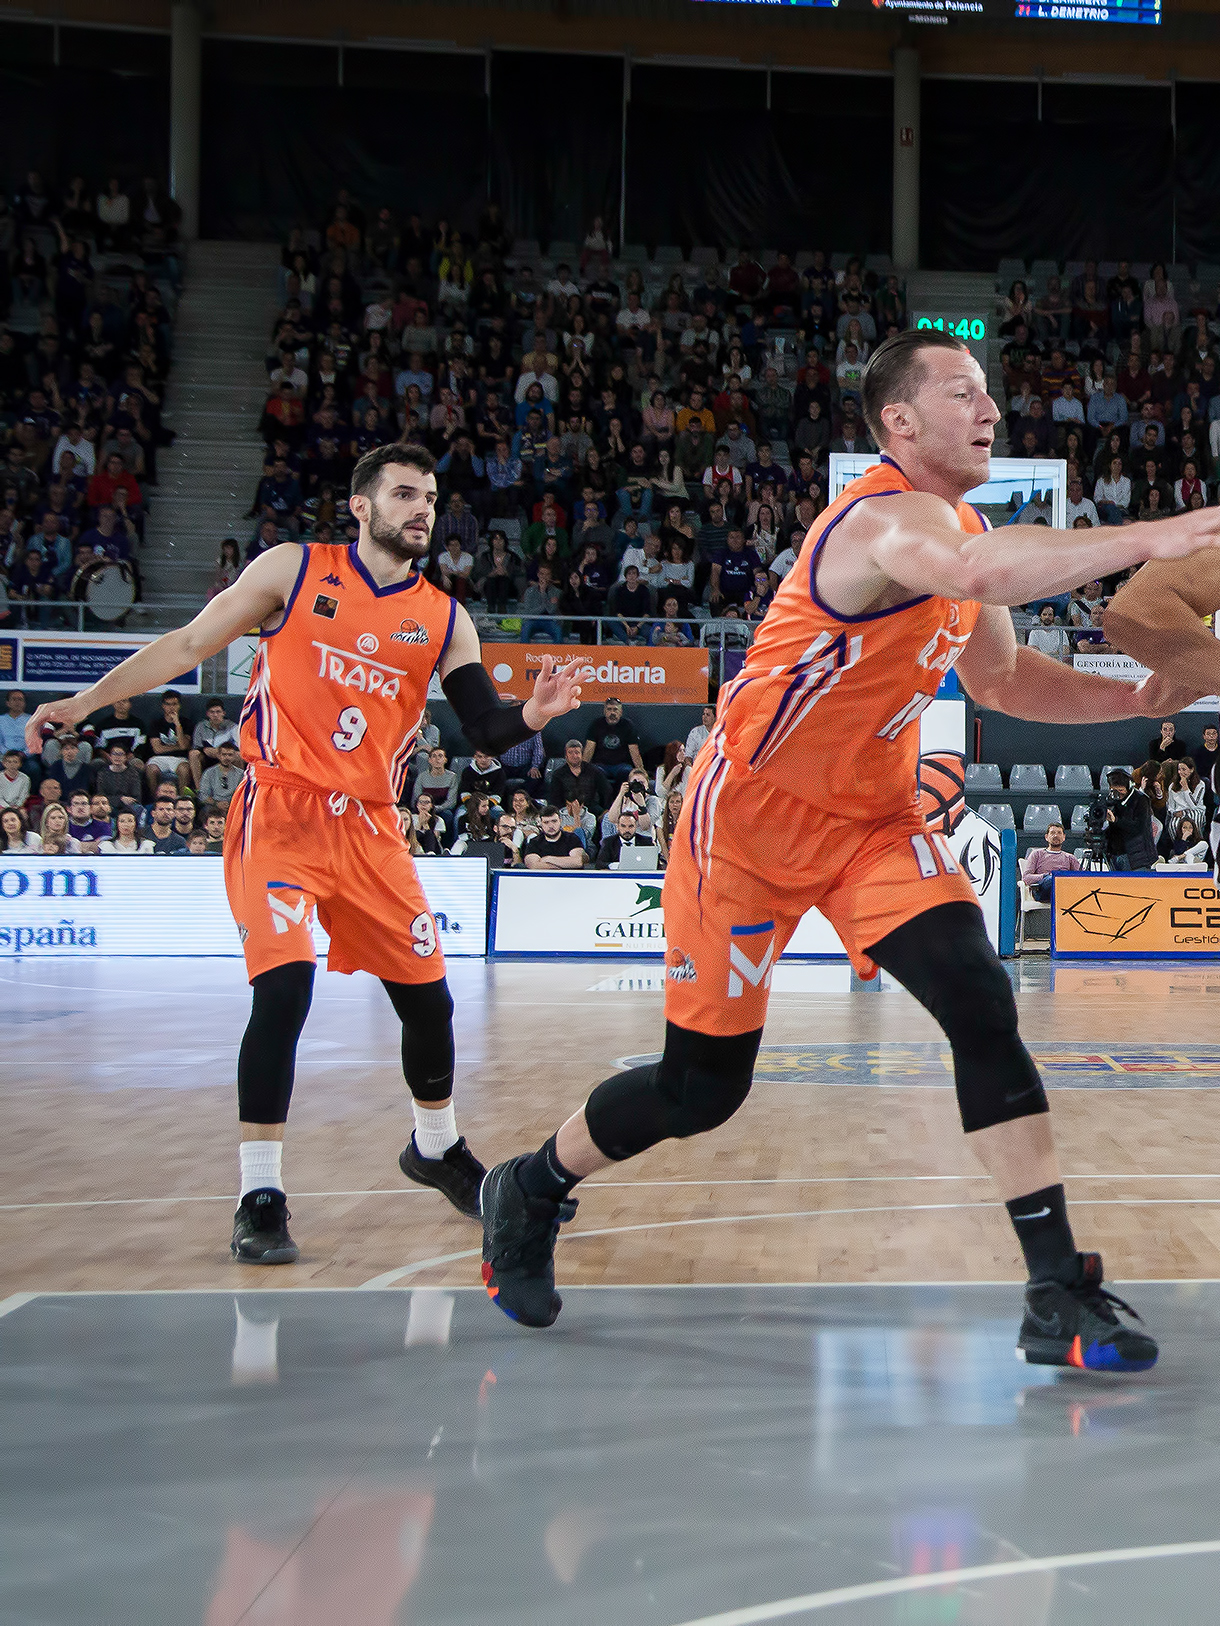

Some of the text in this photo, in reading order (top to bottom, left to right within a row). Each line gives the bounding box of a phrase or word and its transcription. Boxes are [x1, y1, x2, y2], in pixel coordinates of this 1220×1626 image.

[935, 1, 944, 9] de
[945, 1, 983, 12] Palencia
[1050, 5, 1108, 21] DEMETRIO
[312, 639, 408, 701] TRAPA
[1076, 658, 1121, 668] GESTORÍA
[331, 704, 369, 753] 9
[410, 911, 437, 958] 9
[595, 921, 667, 939] GAHE
